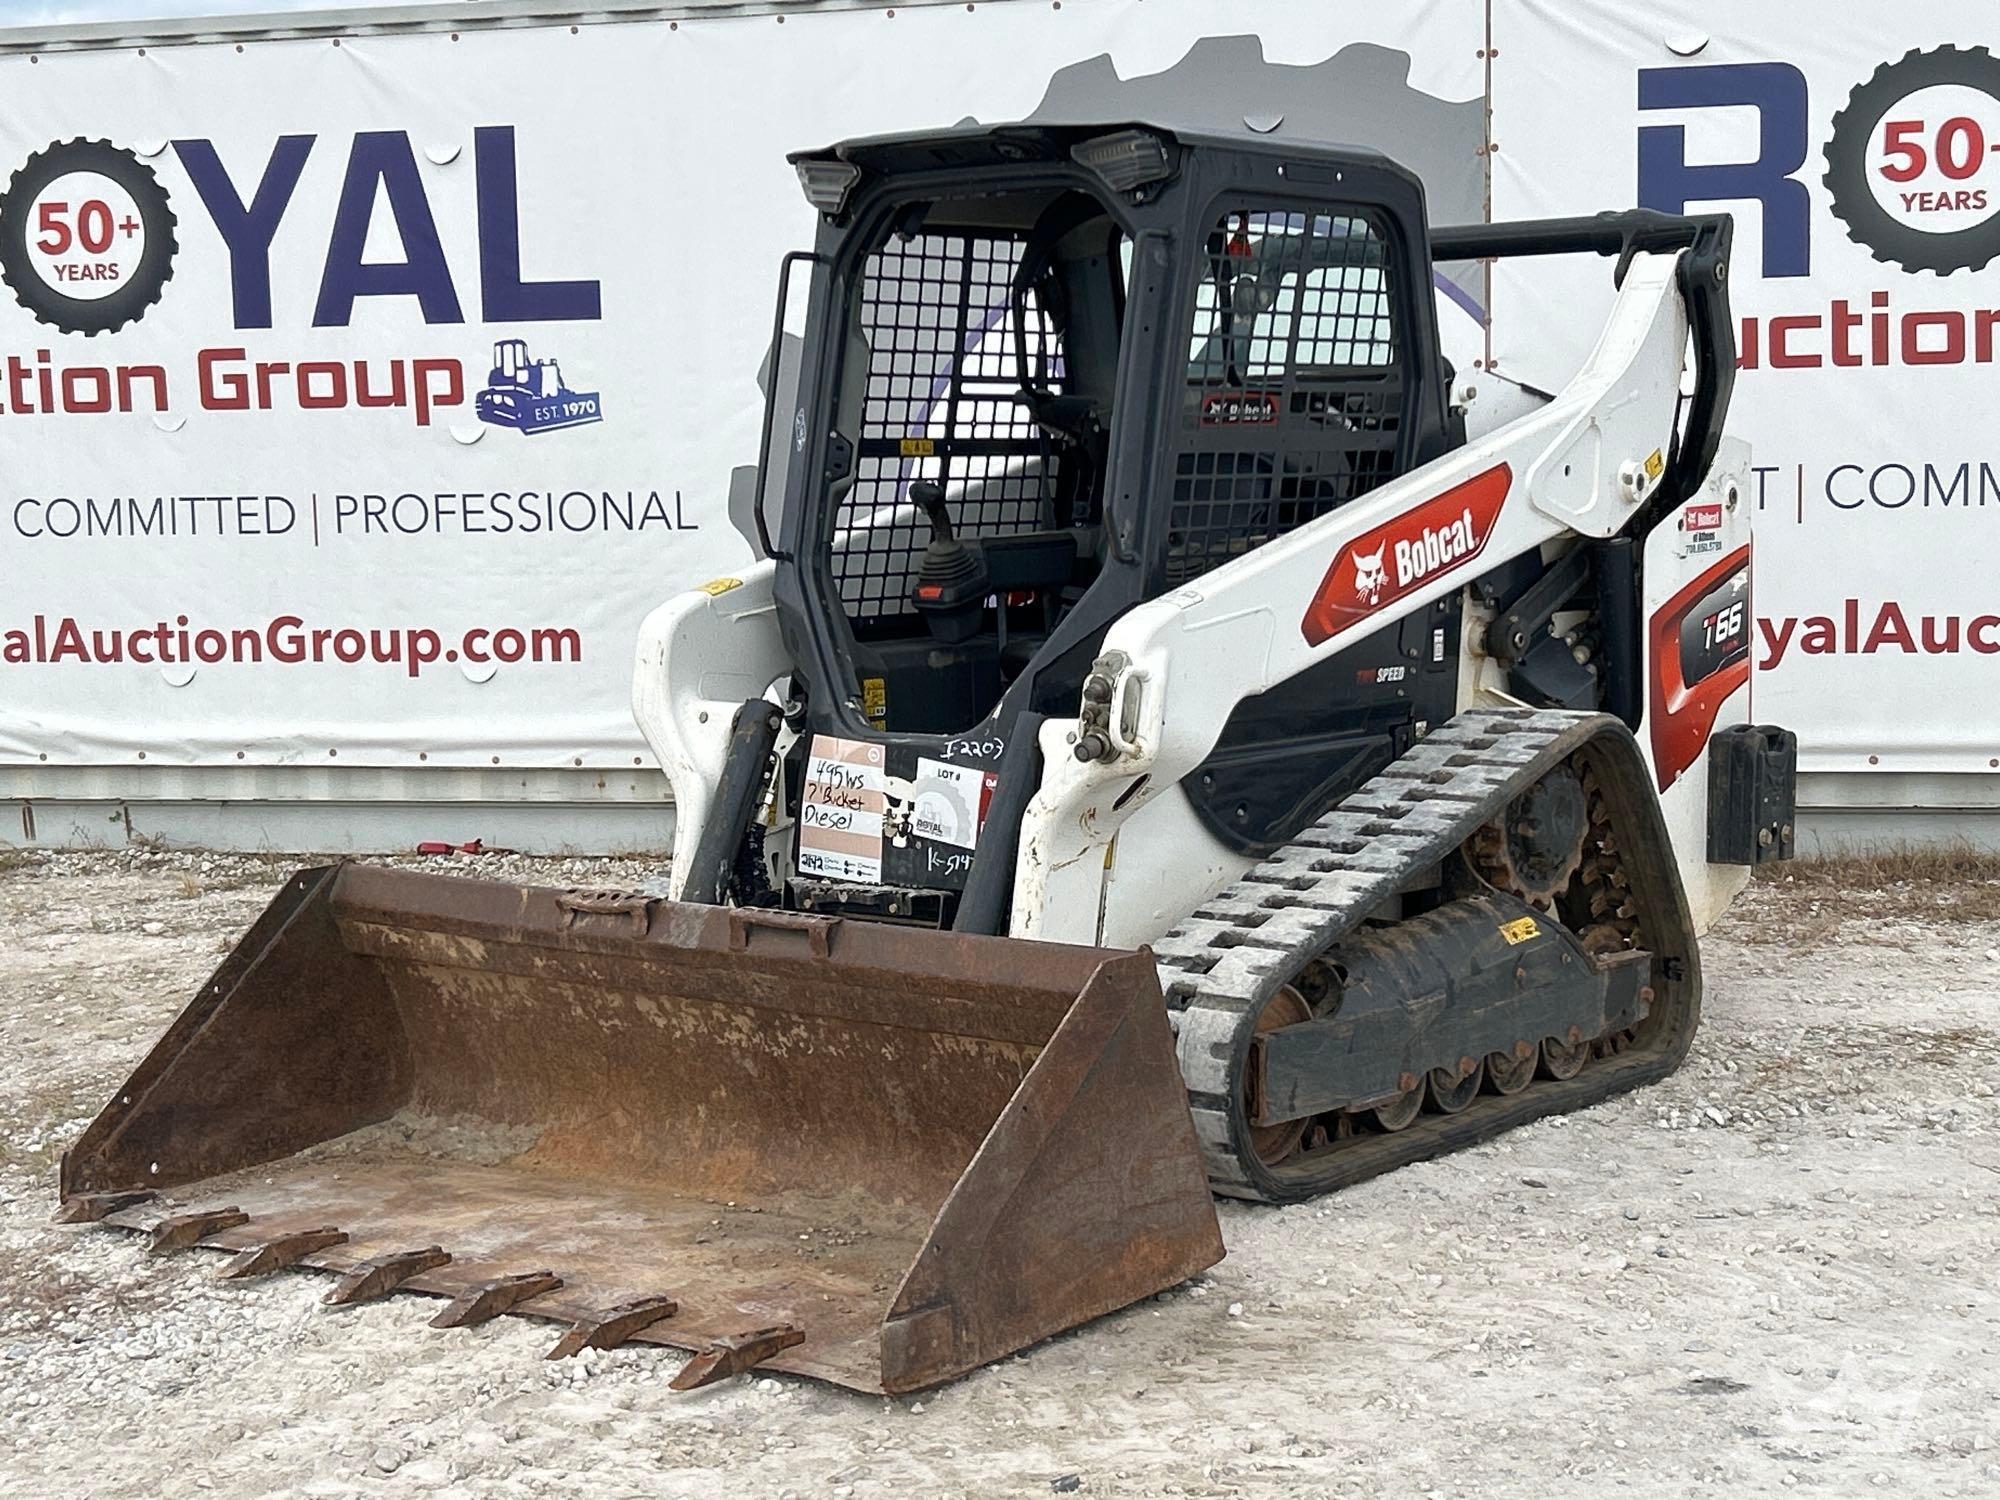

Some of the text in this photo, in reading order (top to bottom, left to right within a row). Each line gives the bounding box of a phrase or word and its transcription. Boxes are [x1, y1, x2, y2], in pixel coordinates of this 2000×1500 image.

[1879, 116, 2000, 183] 50
[1900, 189, 1988, 213] YEARS
[36, 199, 140, 255] 50+
[53, 262, 120, 283] YEARS
[0, 346, 465, 426] tion Group
[535, 400, 597, 421] EST. 1970
[13, 490, 699, 538] COMMITTED PROFESSIONAL
[1394, 508, 1475, 588] Bobcat
[3, 614, 582, 677] alAuctionGroup.com
[1703, 601, 1743, 651] T66
[1376, 666, 1405, 683] SPEED
[816, 760, 844, 790] 495
[937, 768, 954, 781] LOT
[804, 804, 853, 830] Diesel
